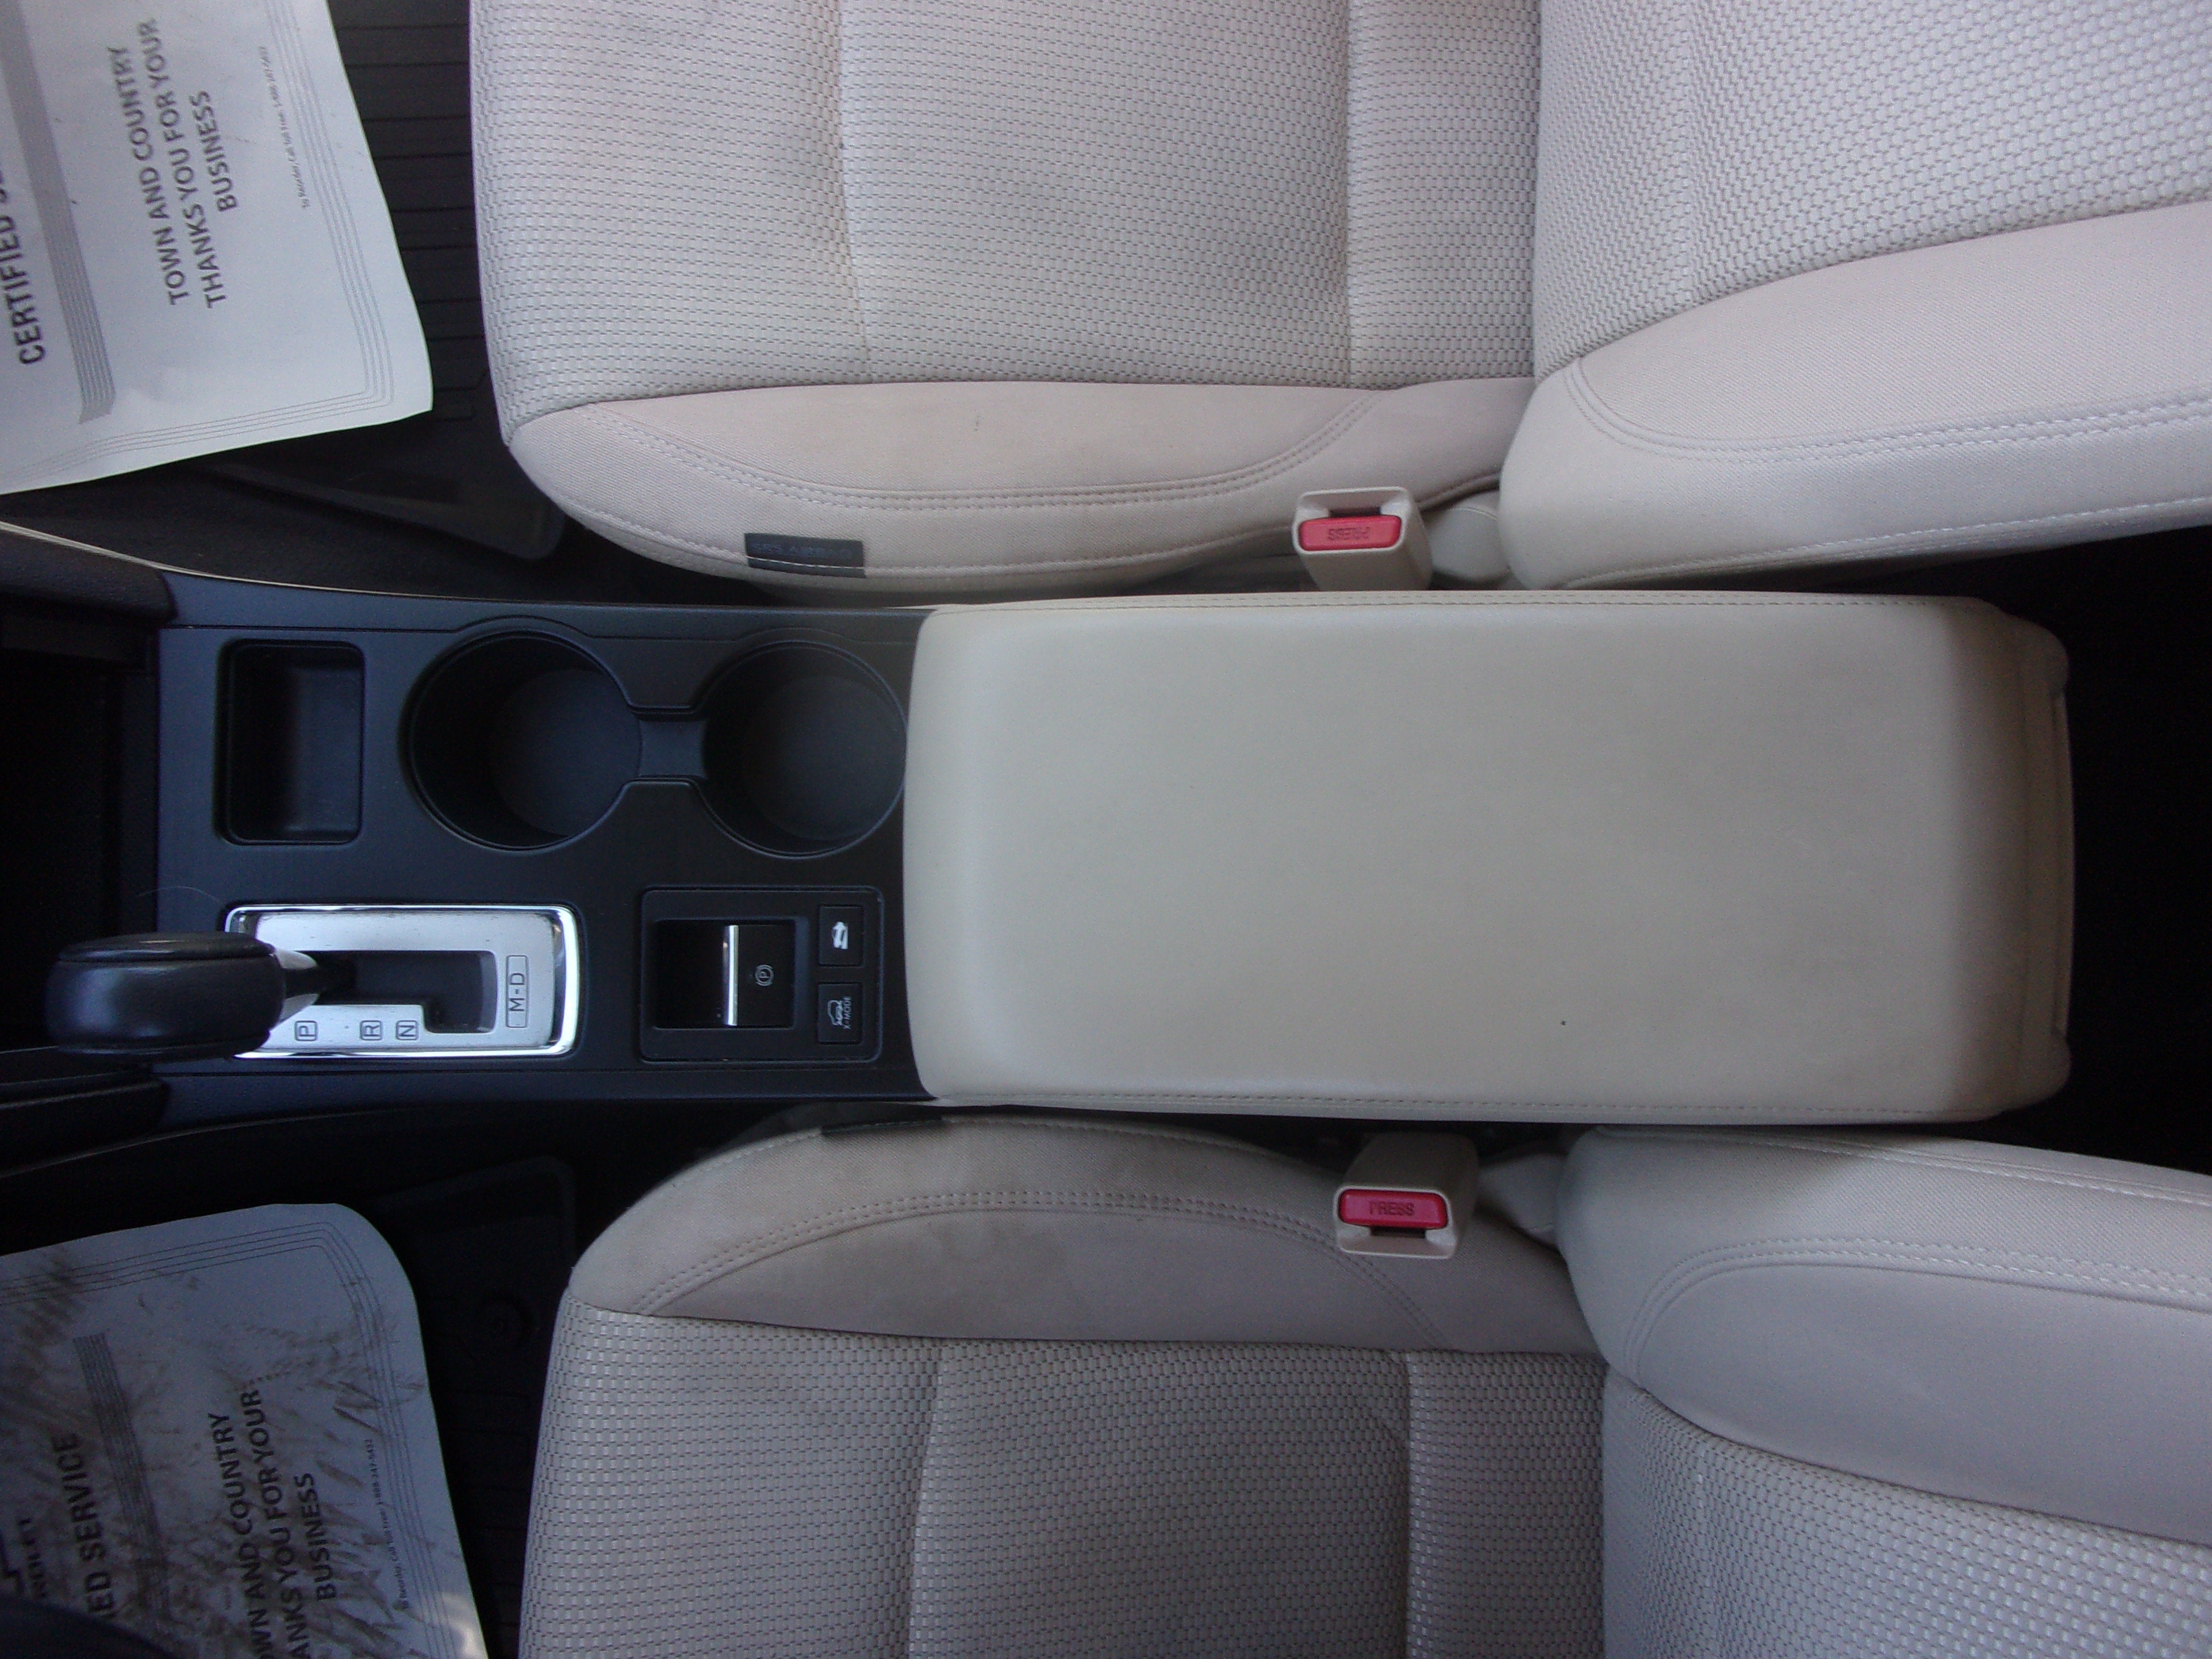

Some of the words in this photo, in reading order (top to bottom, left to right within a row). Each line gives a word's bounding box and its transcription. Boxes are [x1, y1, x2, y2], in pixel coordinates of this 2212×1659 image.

[138, 18, 168, 88] YOUR
[108, 46, 153, 161] COUNTRY
[155, 91, 184, 142] FOR
[168, 147, 198, 201] YOU
[189, 90, 237, 212] BUSINESS
[139, 167, 169, 219] AND
[154, 226, 189, 305] TOWN
[183, 203, 226, 309] THANKS
[0, 215, 45, 365] CERTIFIED
[300, 1024, 314, 1037] P
[364, 1024, 380, 1037] R
[400, 1025, 415, 1037] N
[1369, 1200, 1414, 1216] PRESS
[241, 1390, 274, 1464] YOUR
[51, 1433, 107, 1562] SERVICE
[208, 1412, 252, 1536] COUNTRY
[258, 1467, 288, 1521] FOR
[270, 1527, 297, 1584] YOU
[293, 1472, 336, 1601] BUSINESS
[239, 1542, 266, 1599] AND
[247, 1608, 274, 1659] WN
[281, 1587, 311, 1659] ANKS
